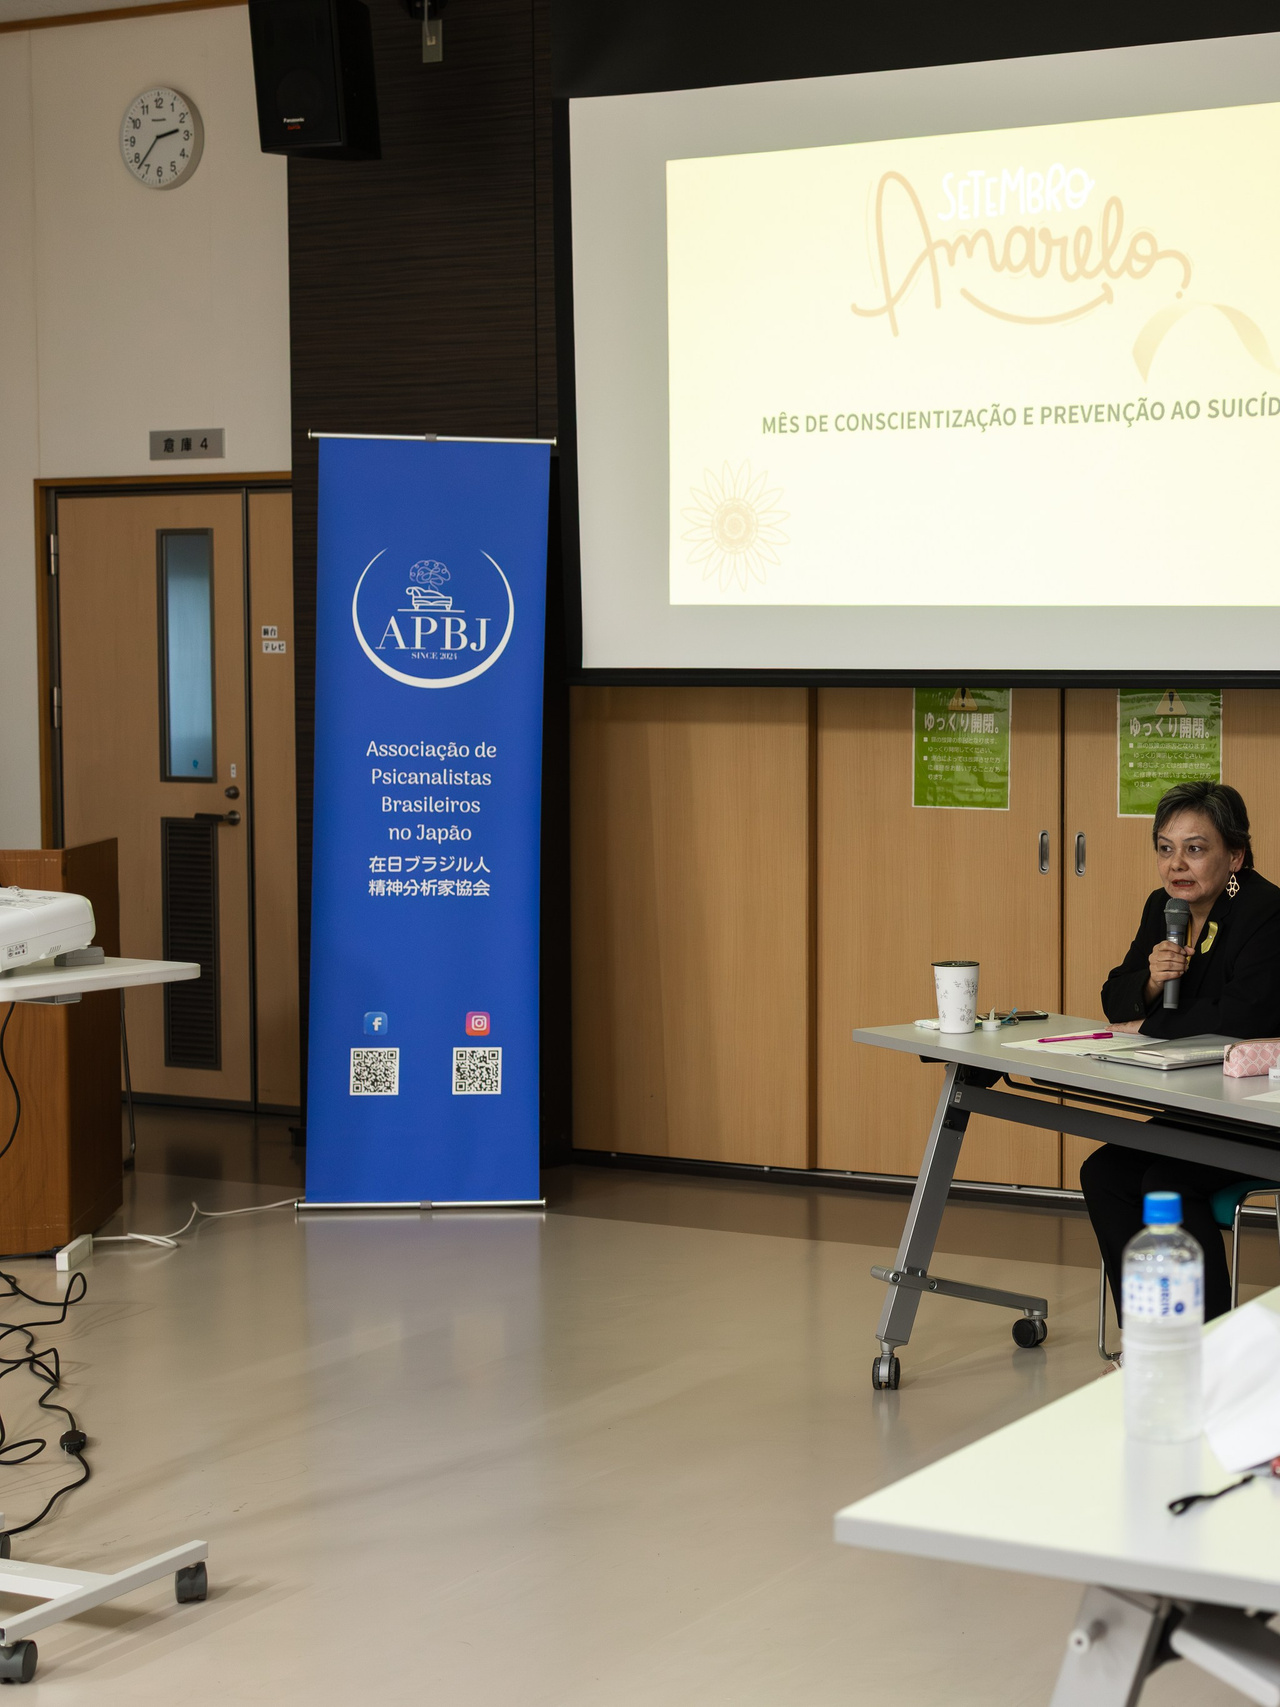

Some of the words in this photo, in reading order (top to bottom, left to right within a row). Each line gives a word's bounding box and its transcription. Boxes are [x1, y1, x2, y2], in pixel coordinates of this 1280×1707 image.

[154, 97, 164, 109] 12
[170, 102, 174, 112] 1
[141, 104, 149, 115] 11
[132, 118, 141, 129] 10
[179, 112, 185, 123] 2
[130, 136, 136, 147] 9
[183, 130, 189, 141] 3
[134, 153, 140, 163] 8
[180, 148, 185, 159] 4
[144, 164, 150, 174] 7
[157, 166, 162, 177] 6
[170, 161, 176, 172] 5
[937, 162, 1095, 221] SETEMBRO
[851, 170, 1192, 338] Amarelo
[762, 411, 800, 434] MÊS
[805, 415, 829, 432] DE
[834, 404, 1016, 432] CONSCIENTIZAÇÃO
[1023, 407, 1034, 425] E
[1040, 397, 1166, 428] PREVENÇÃO
[1170, 400, 1201, 420] AO
[375, 615, 492, 652] APBJ
[411, 652, 438, 660] SINCE
[924, 712, 999, 734] ゆっくり開閉。
[1130, 717, 1210, 738] ゆっくり開閉。
[366, 740, 470, 761] Associação
[474, 742, 497, 758] de
[371, 768, 492, 786] Psicanalistas
[382, 796, 481, 814] Brasileiros
[388, 827, 412, 840] no
[416, 824, 472, 845] Japão
[368, 855, 491, 873] 在日ブラジル人
[368, 879, 491, 897] 精神分析家協会
